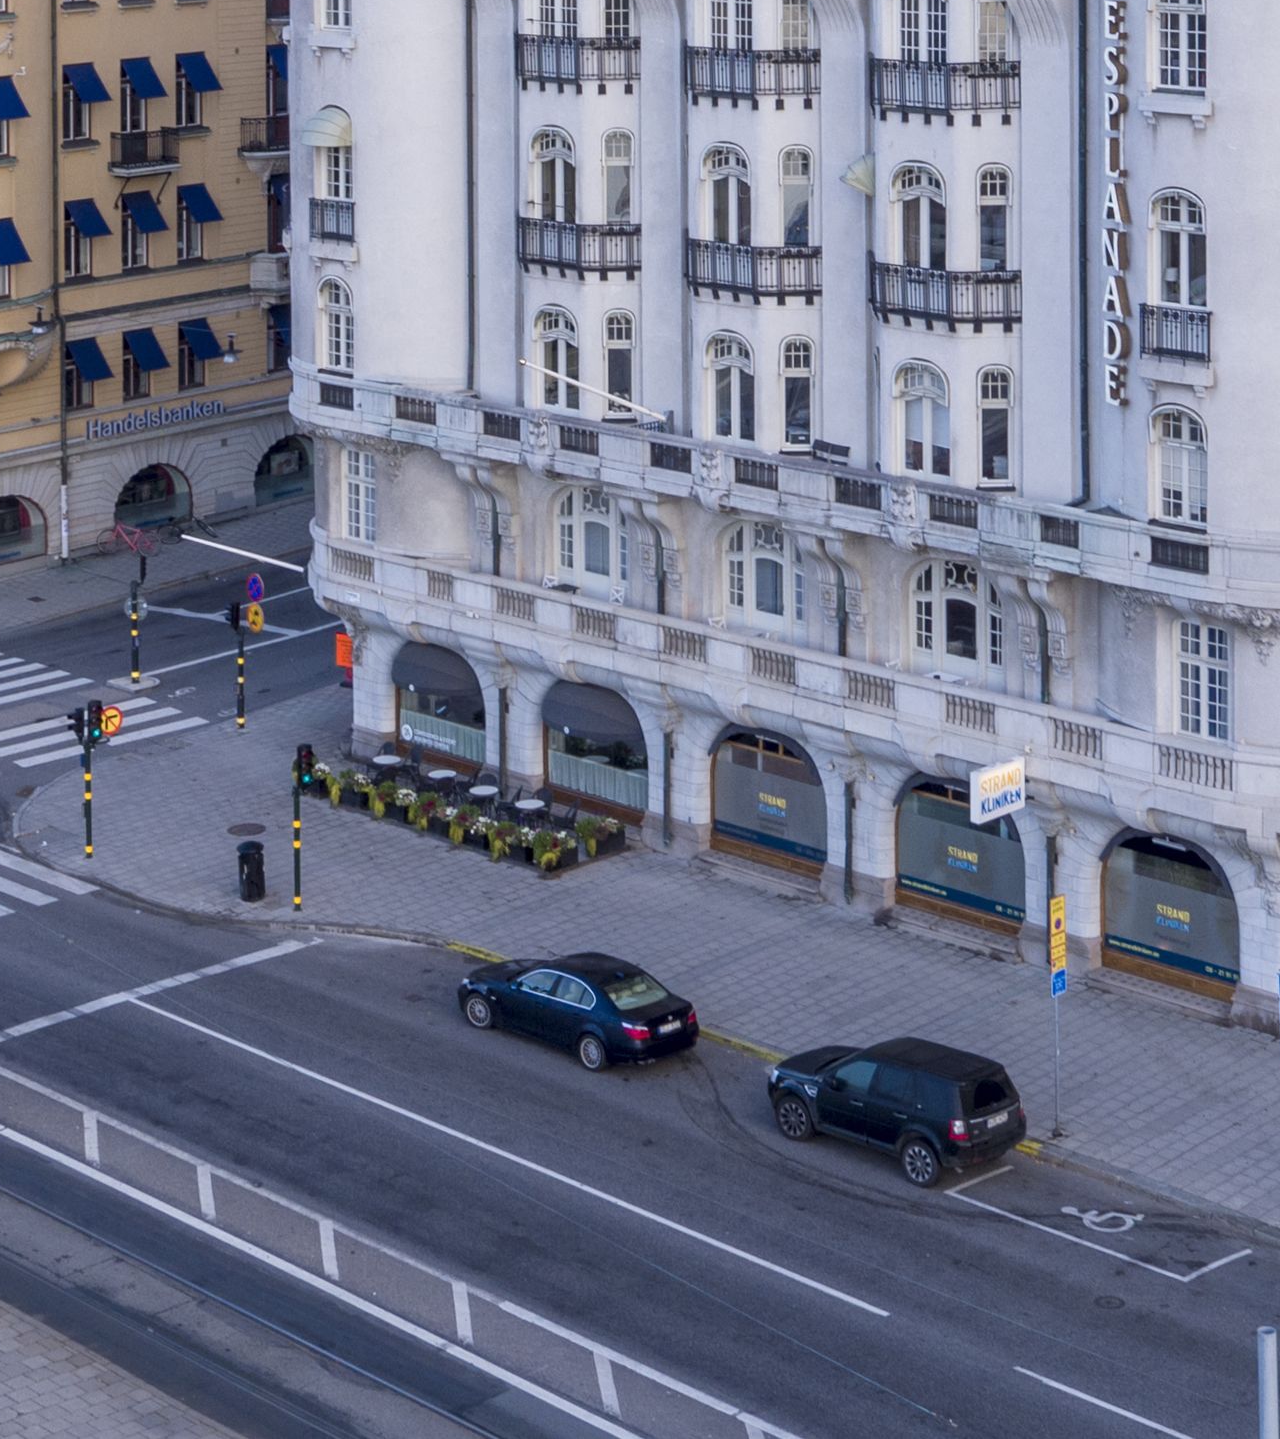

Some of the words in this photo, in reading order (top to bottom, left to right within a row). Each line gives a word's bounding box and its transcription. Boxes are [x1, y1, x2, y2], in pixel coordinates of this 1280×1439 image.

[1103, 0, 1126, 407] ESPLANADE
[87, 399, 225, 440] Handelsbanken
[980, 768, 1021, 796] STRAND
[758, 792, 786, 809] STRAND
[980, 788, 1022, 815] KLINIKEN
[947, 845, 979, 864] STRAND
[1156, 903, 1191, 923] STRAND
